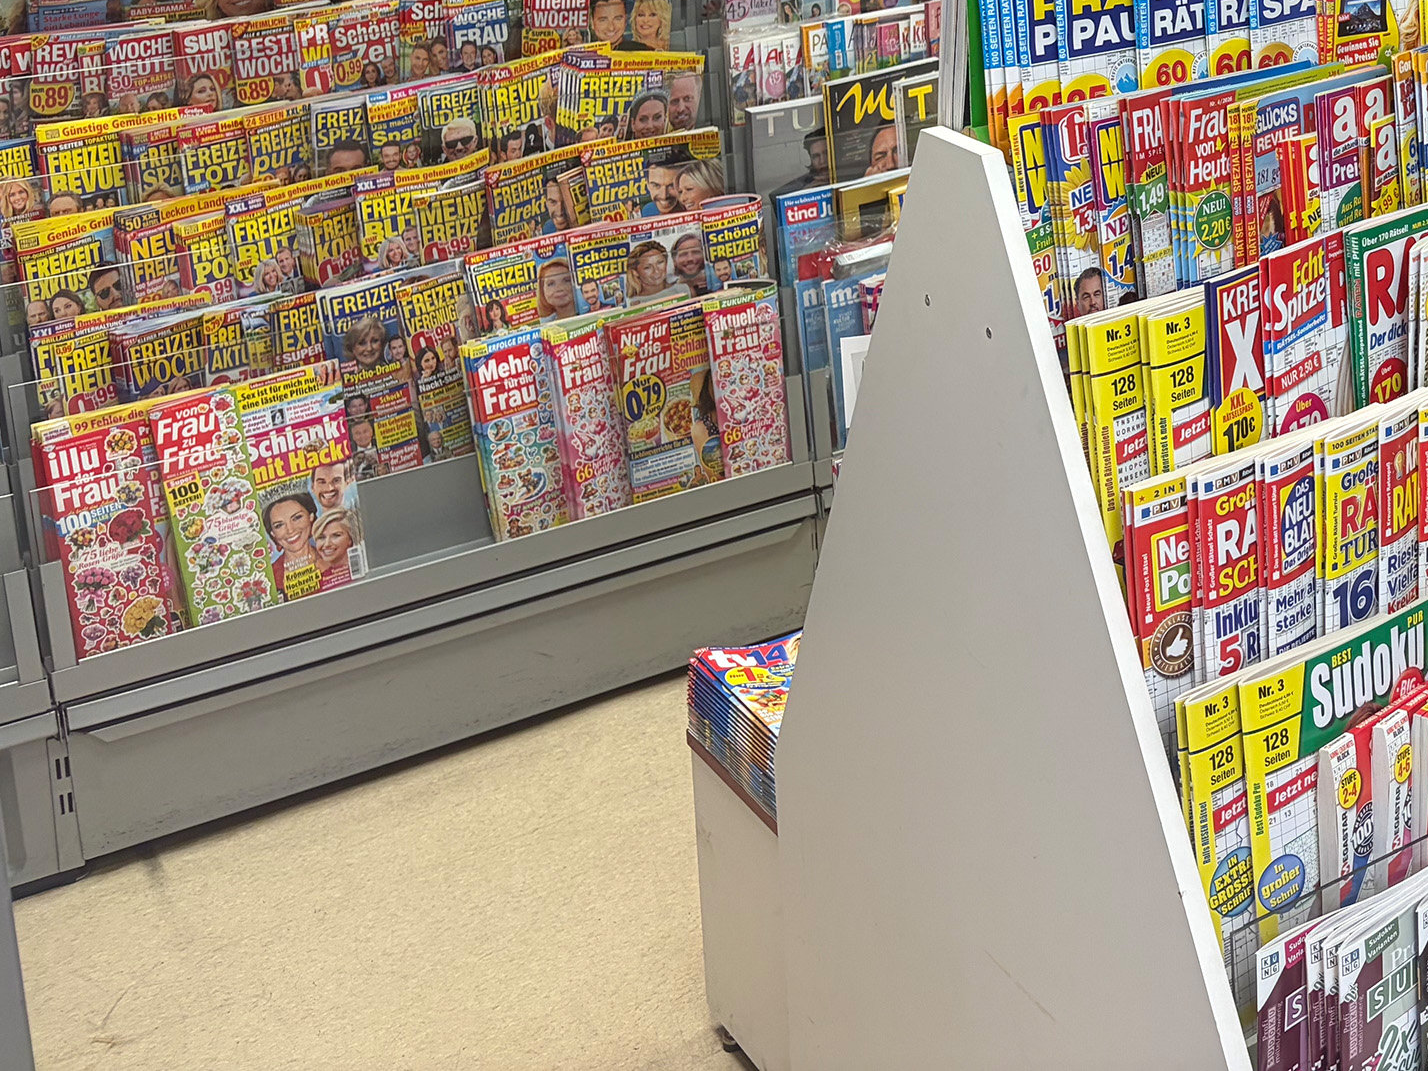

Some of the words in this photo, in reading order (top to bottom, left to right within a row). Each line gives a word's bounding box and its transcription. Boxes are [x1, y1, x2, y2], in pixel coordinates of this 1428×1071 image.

[534, 9, 587, 28] WOCHE
[625, 60, 654, 68] geheime
[655, 58, 700, 68] Renten-Tricks
[62, 121, 109, 138] Günstige
[111, 113, 178, 132] Gemüse-Hits
[586, 158, 645, 186] FREIZEIT
[591, 179, 648, 206] direkt
[1139, 187, 1165, 211] 1,49
[575, 246, 627, 266] Schöne
[1292, 250, 1325, 286] Echt
[576, 258, 628, 282] FREIZEIT
[620, 329, 646, 349] Nur
[648, 324, 668, 343] für
[640, 342, 661, 360] die
[478, 355, 534, 378] Mehr
[623, 356, 671, 381] Frau
[504, 376, 519, 390] für
[522, 374, 534, 385] die
[1111, 375, 1137, 397] 128
[483, 385, 537, 416] Frau
[1112, 394, 1137, 410] Seiten
[176, 406, 199, 421] von
[157, 415, 217, 445] Frau
[182, 437, 196, 448] zu
[48, 447, 100, 478] illu
[164, 445, 220, 474] Frau
[53, 480, 117, 513] Frau
[169, 483, 199, 498] 100
[174, 494, 202, 508] SEITEN!
[58, 508, 91, 534] 100
[90, 502, 122, 519] SEITEN
[708, 644, 789, 668] tv14
[1310, 624, 1425, 728] Sudoku
[1262, 729, 1290, 752] 128
[1264, 748, 1291, 768] Seiten
